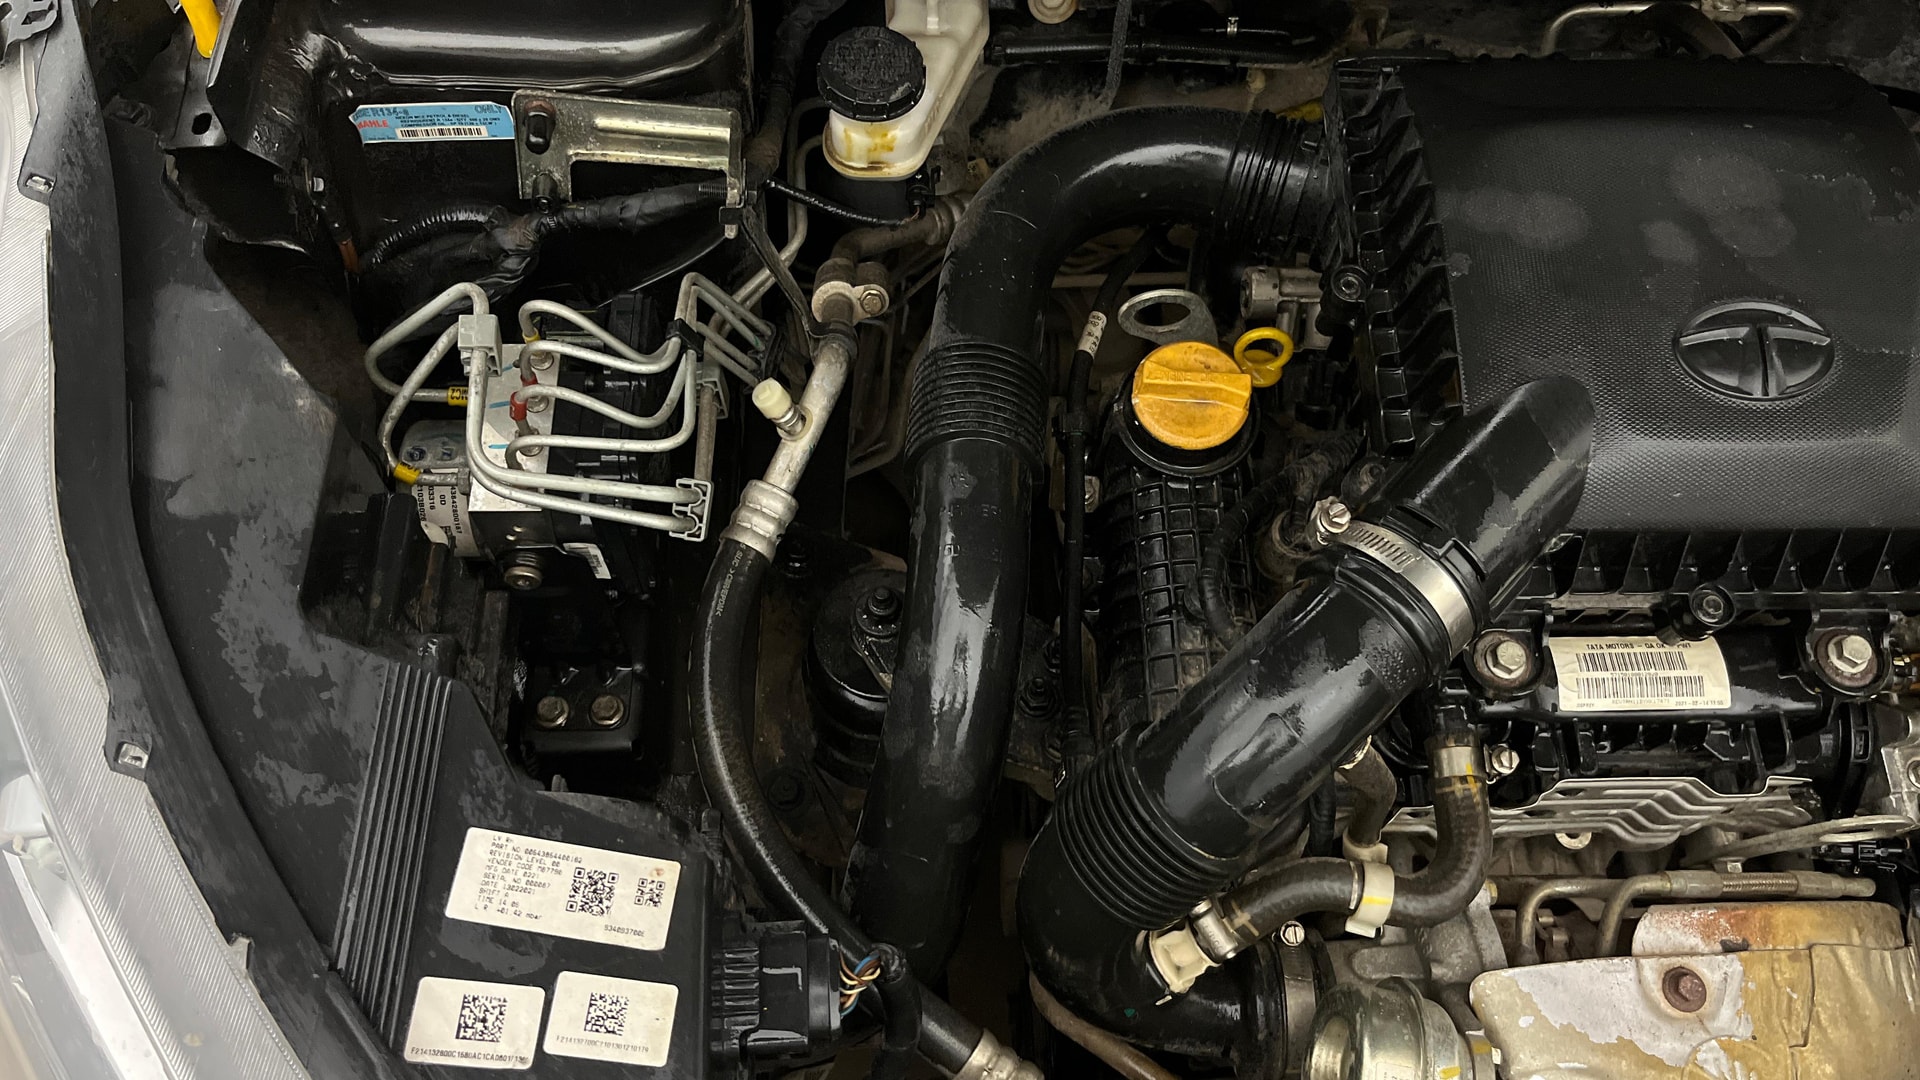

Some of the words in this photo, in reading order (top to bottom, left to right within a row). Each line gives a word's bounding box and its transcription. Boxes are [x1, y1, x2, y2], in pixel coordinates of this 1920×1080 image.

[489, 850, 523, 860] REVISION
[487, 858, 512, 866] VENDER
[516, 862, 533, 870] CODE
[483, 873, 507, 881] SERIAL
